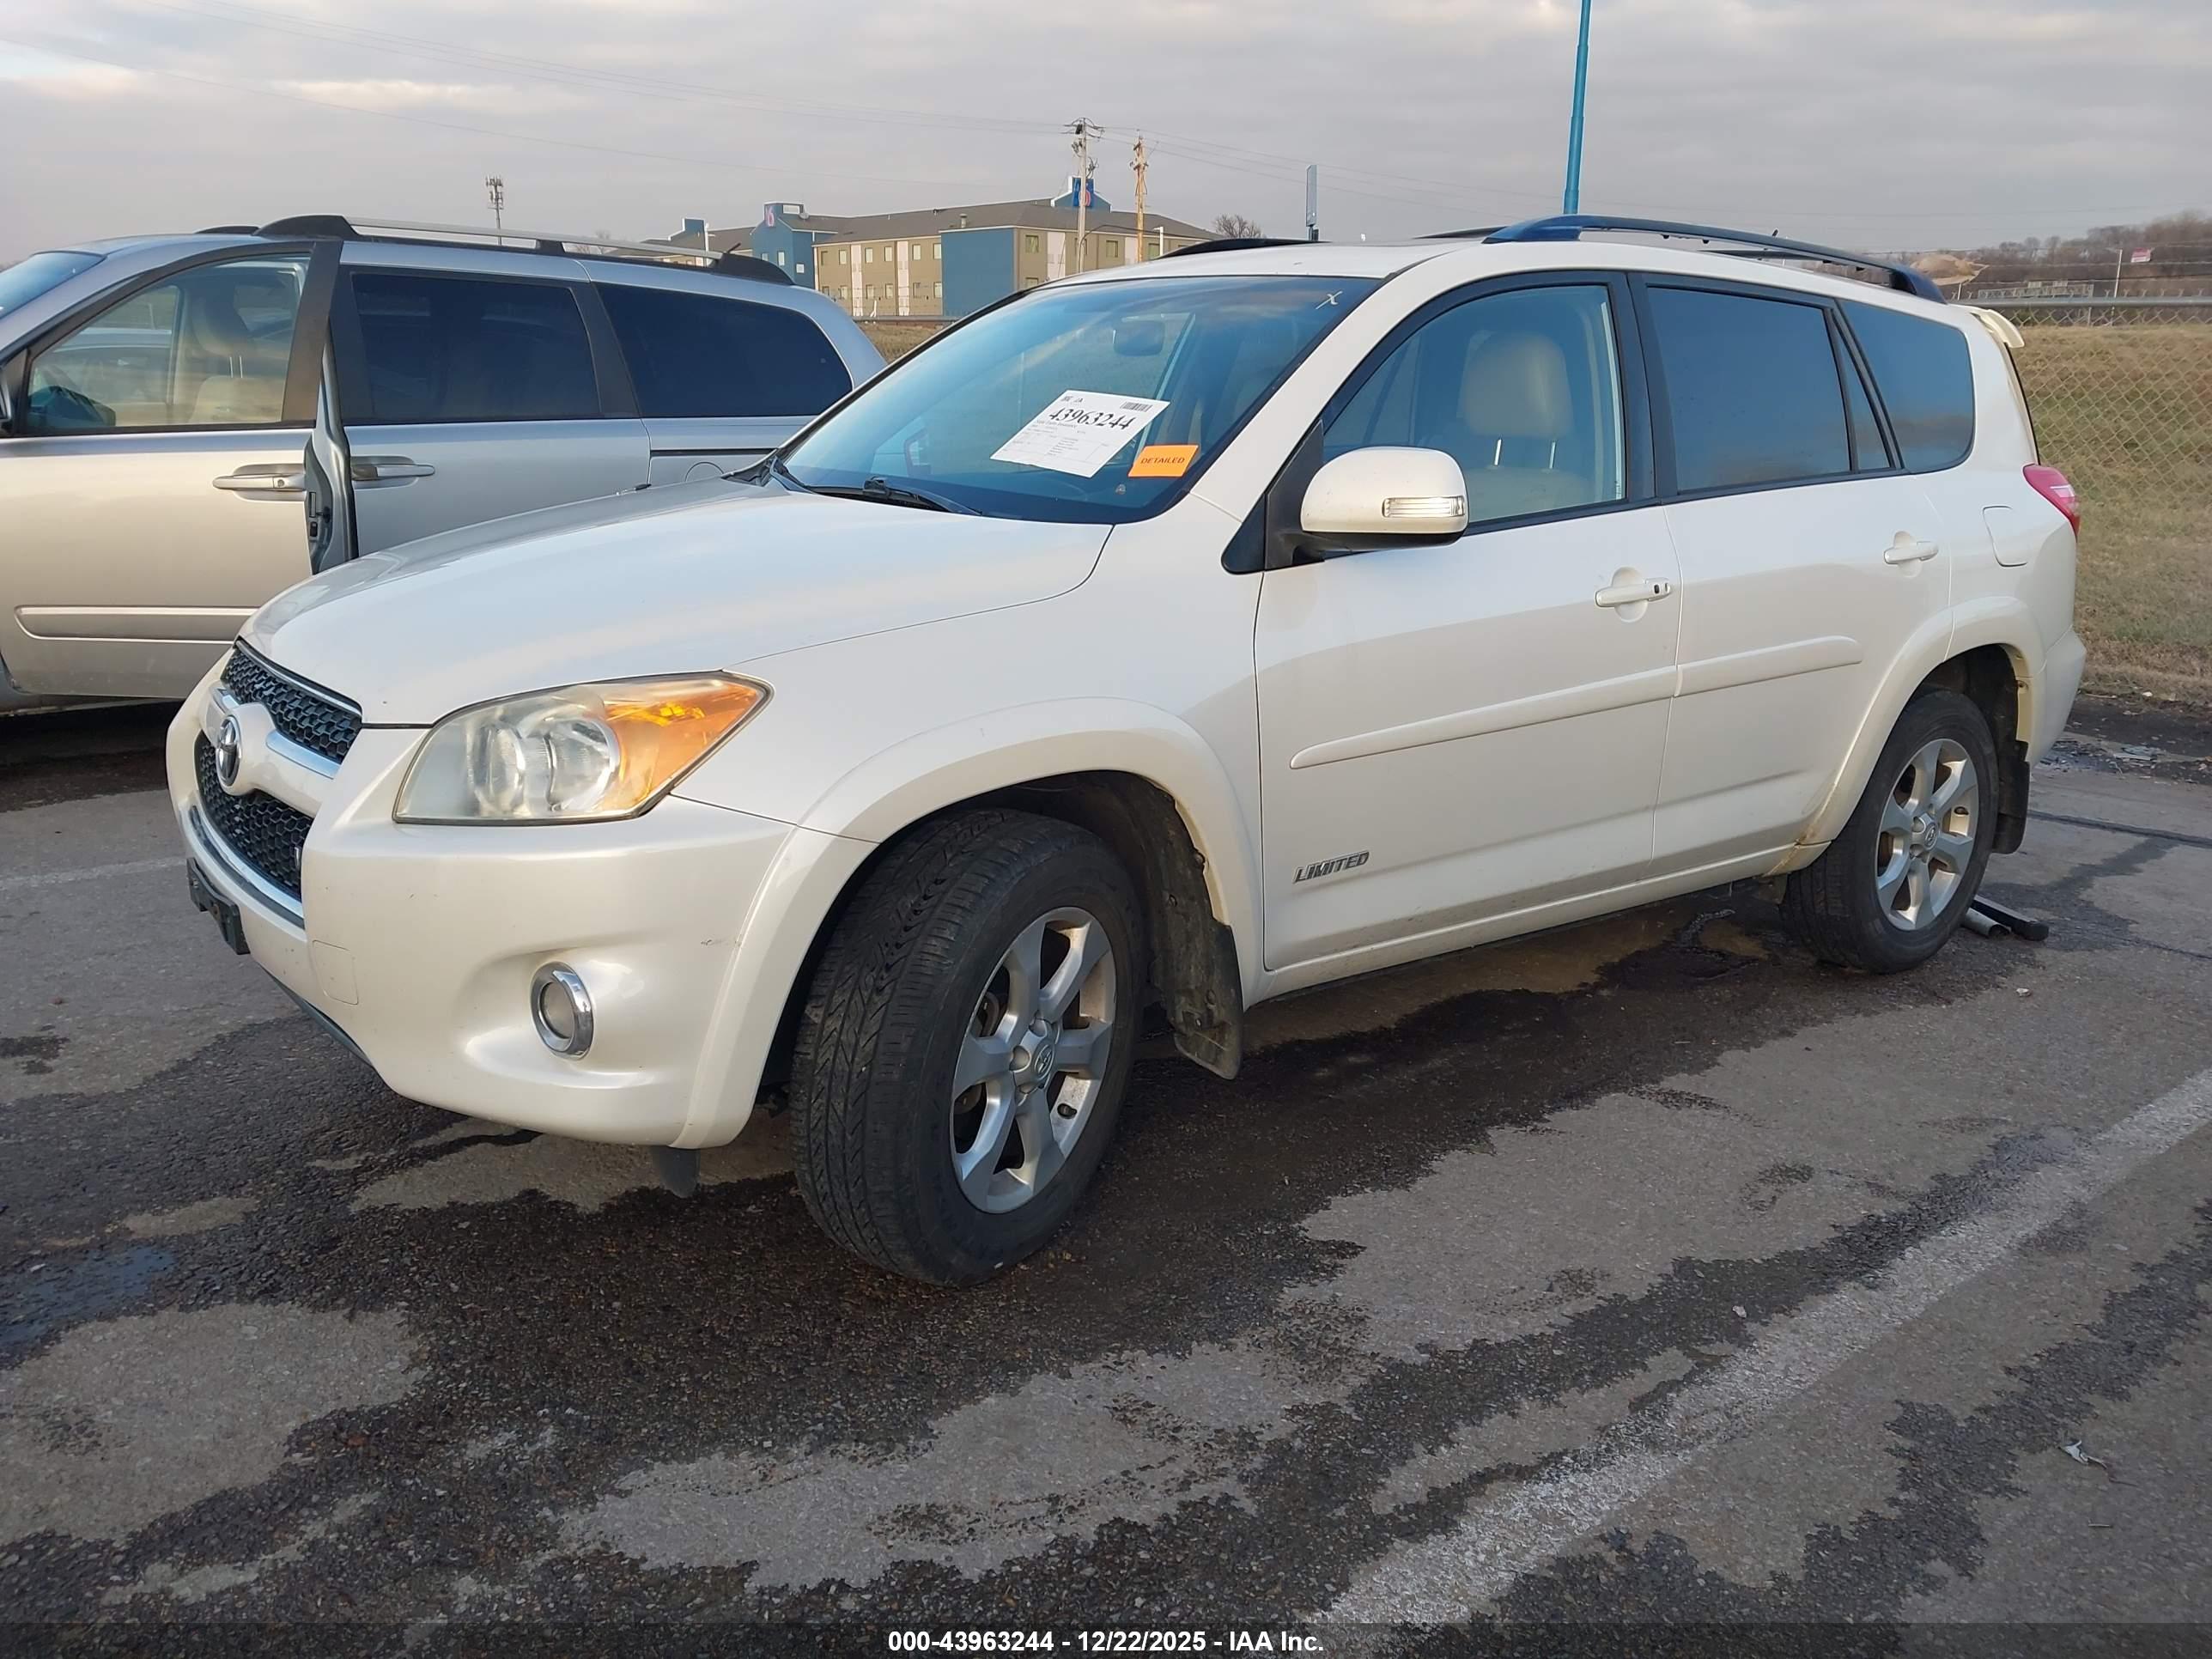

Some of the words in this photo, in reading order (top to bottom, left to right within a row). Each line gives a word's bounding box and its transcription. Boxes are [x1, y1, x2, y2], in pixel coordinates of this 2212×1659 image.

[1048, 407, 1136, 430] 43963244
[1139, 456, 1185, 465] DETAILED
[1292, 850, 1370, 884] LIMITED
